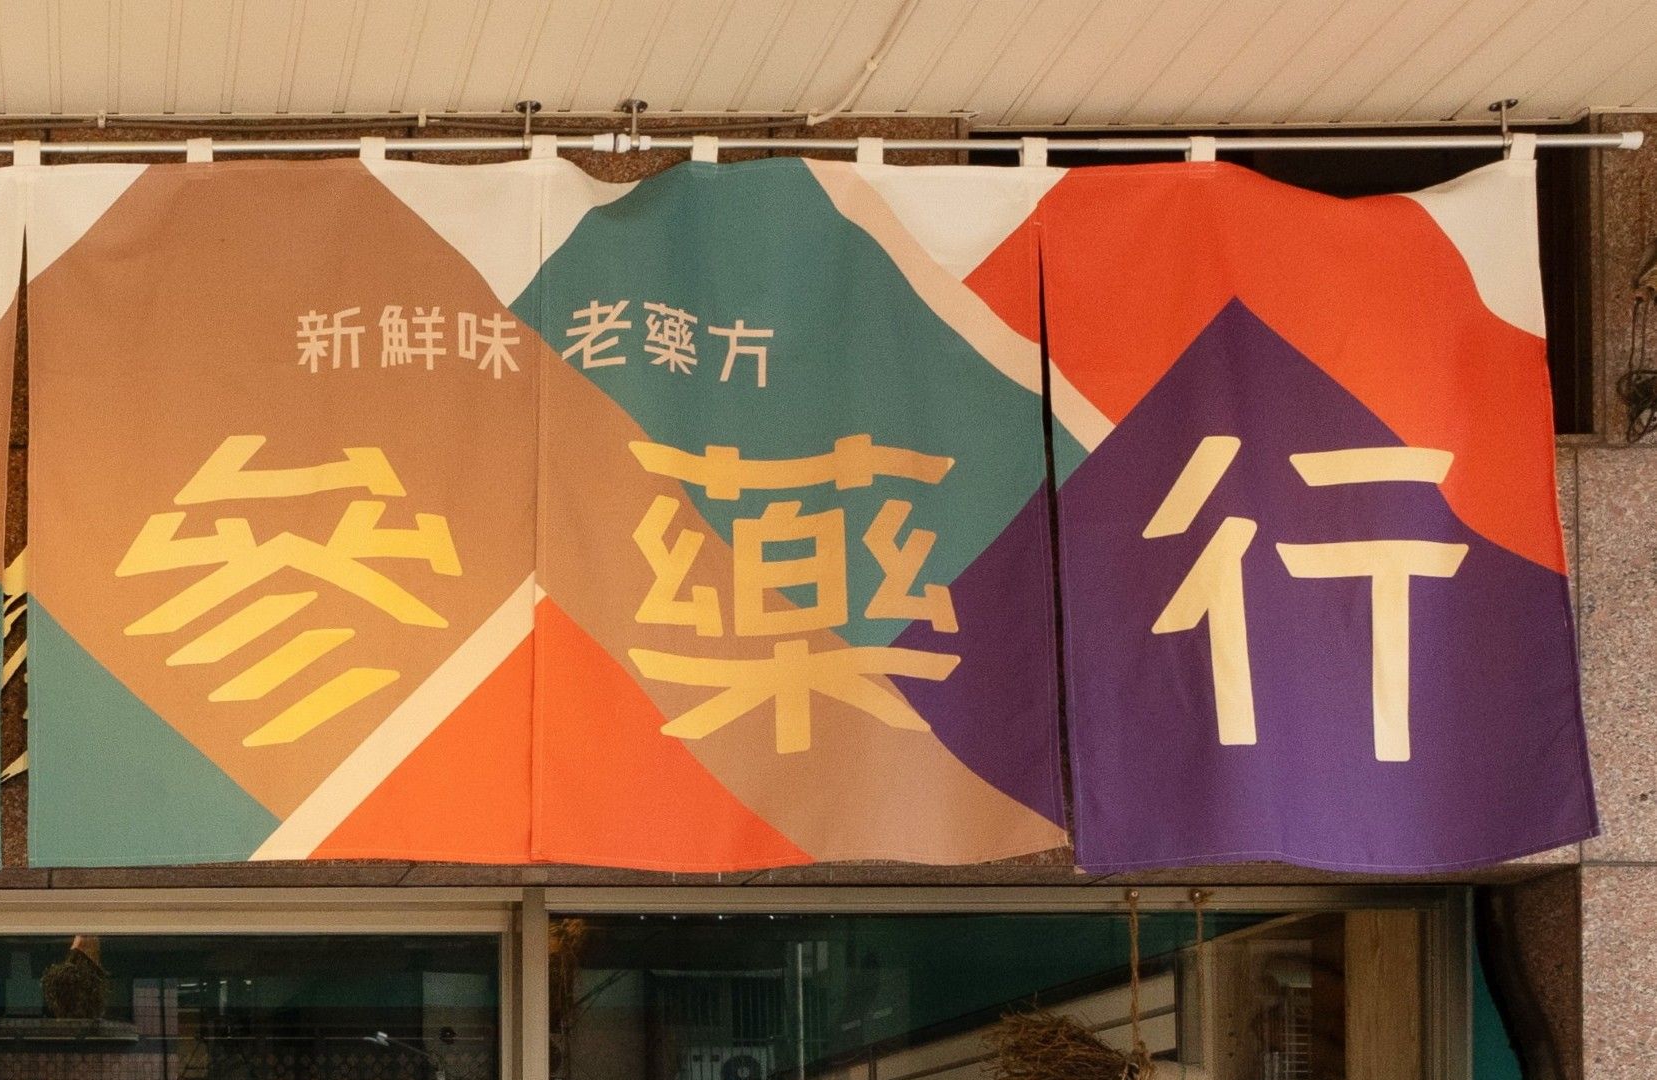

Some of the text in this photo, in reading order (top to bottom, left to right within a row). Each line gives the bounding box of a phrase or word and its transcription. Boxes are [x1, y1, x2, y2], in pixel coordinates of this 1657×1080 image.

[296, 299, 775, 388] 新鮮味 老藥方
